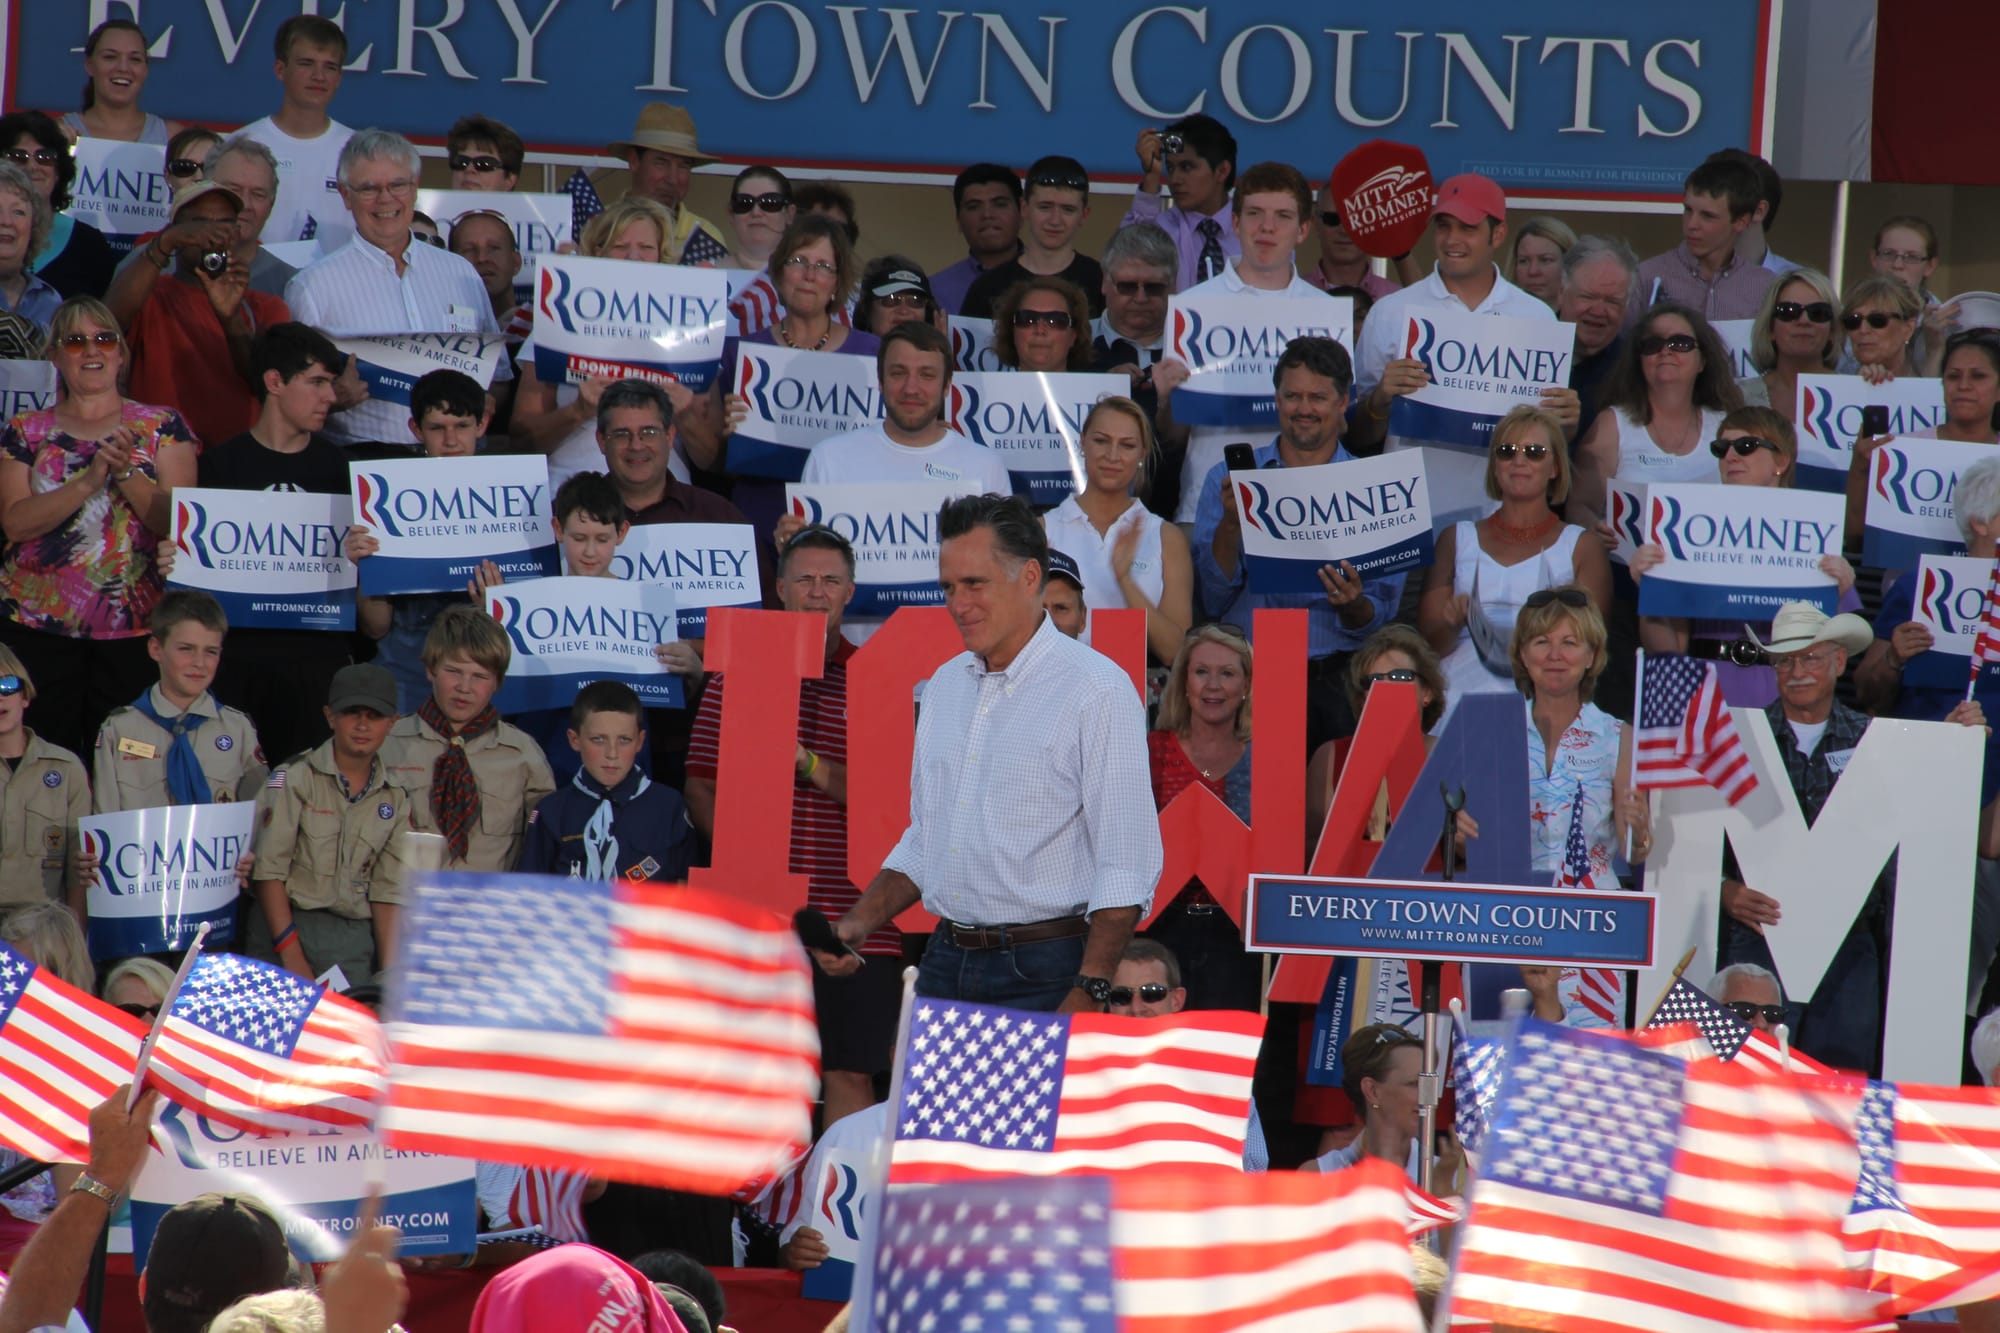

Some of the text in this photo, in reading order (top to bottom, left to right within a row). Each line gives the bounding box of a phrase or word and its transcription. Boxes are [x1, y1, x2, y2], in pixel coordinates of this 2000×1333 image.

[70, 0, 1703, 138] VRY TOWN COUNTS
[70, 199, 170, 219] LIEVE IN AMERIC
[1343, 181, 1397, 215] MITT
[1348, 186, 1430, 231] ROMNEY
[1359, 225, 1376, 237] FOR
[540, 266, 721, 335] ROMNEY
[583, 324, 711, 345] BELIEVE IN AICA
[1174, 307, 1346, 369] ROMN
[359, 336, 480, 374] LIEVE IN AMERICA
[1405, 317, 1568, 386] ROMNEY
[569, 356, 576, 369] I
[578, 358, 621, 378] DON'T
[1216, 361, 1263, 375] LIEVE
[739, 354, 887, 424] ROMN
[1443, 377, 1542, 398] BELIEVE IN AMER
[780, 413, 830, 430] BELIEVE
[835, 420, 847, 432] IN
[951, 383, 1095, 448] ROMN
[994, 438, 1061, 449] BELIEVE IN
[356, 473, 544, 538] ROMNEY
[1238, 476, 1420, 541] ROMNEY
[1919, 505, 1954, 519] BELIE
[177, 500, 351, 569] ROMNEY
[408, 520, 540, 538] BELIEVE IN AMERICA
[1290, 512, 1417, 541] BELIEVE IN AMERICA
[1650, 496, 1839, 561] ROMNEY
[219, 559, 342, 575] BELIEVE IN AMERICA
[449, 562, 544, 576] MITTNEY.COM
[612, 549, 751, 582] OMNEY
[854, 550, 889, 562] LIEVE
[895, 550, 907, 561] IN
[1336, 547, 1421, 577] IROMNEY.COM
[1692, 551, 1818, 570] BELIEVE IN AMERIC
[688, 580, 745, 591] AMERICA
[876, 591, 945, 602] MITTROMNEY
[251, 602, 341, 615] MITTROMNEY.COM
[492, 596, 671, 656] ROMNEY
[538, 640, 665, 658] BELIEVE IN AMERI
[84, 829, 248, 896] ROMNEY
[127, 873, 237, 896] BLIEVE IN AMERI
[1288, 893, 1618, 934] EVERY TOWN COUNTS
[1360, 926, 1545, 947] WWW.MITTROMNEY.COM
[1378, 959, 1393, 995] LIEVE
[1324, 975, 1348, 1072] MITTROMNEY.COM
[217, 1142, 448, 1169] BELIEVE IN AMER
[284, 1210, 450, 1235] MTRONEY.COM
